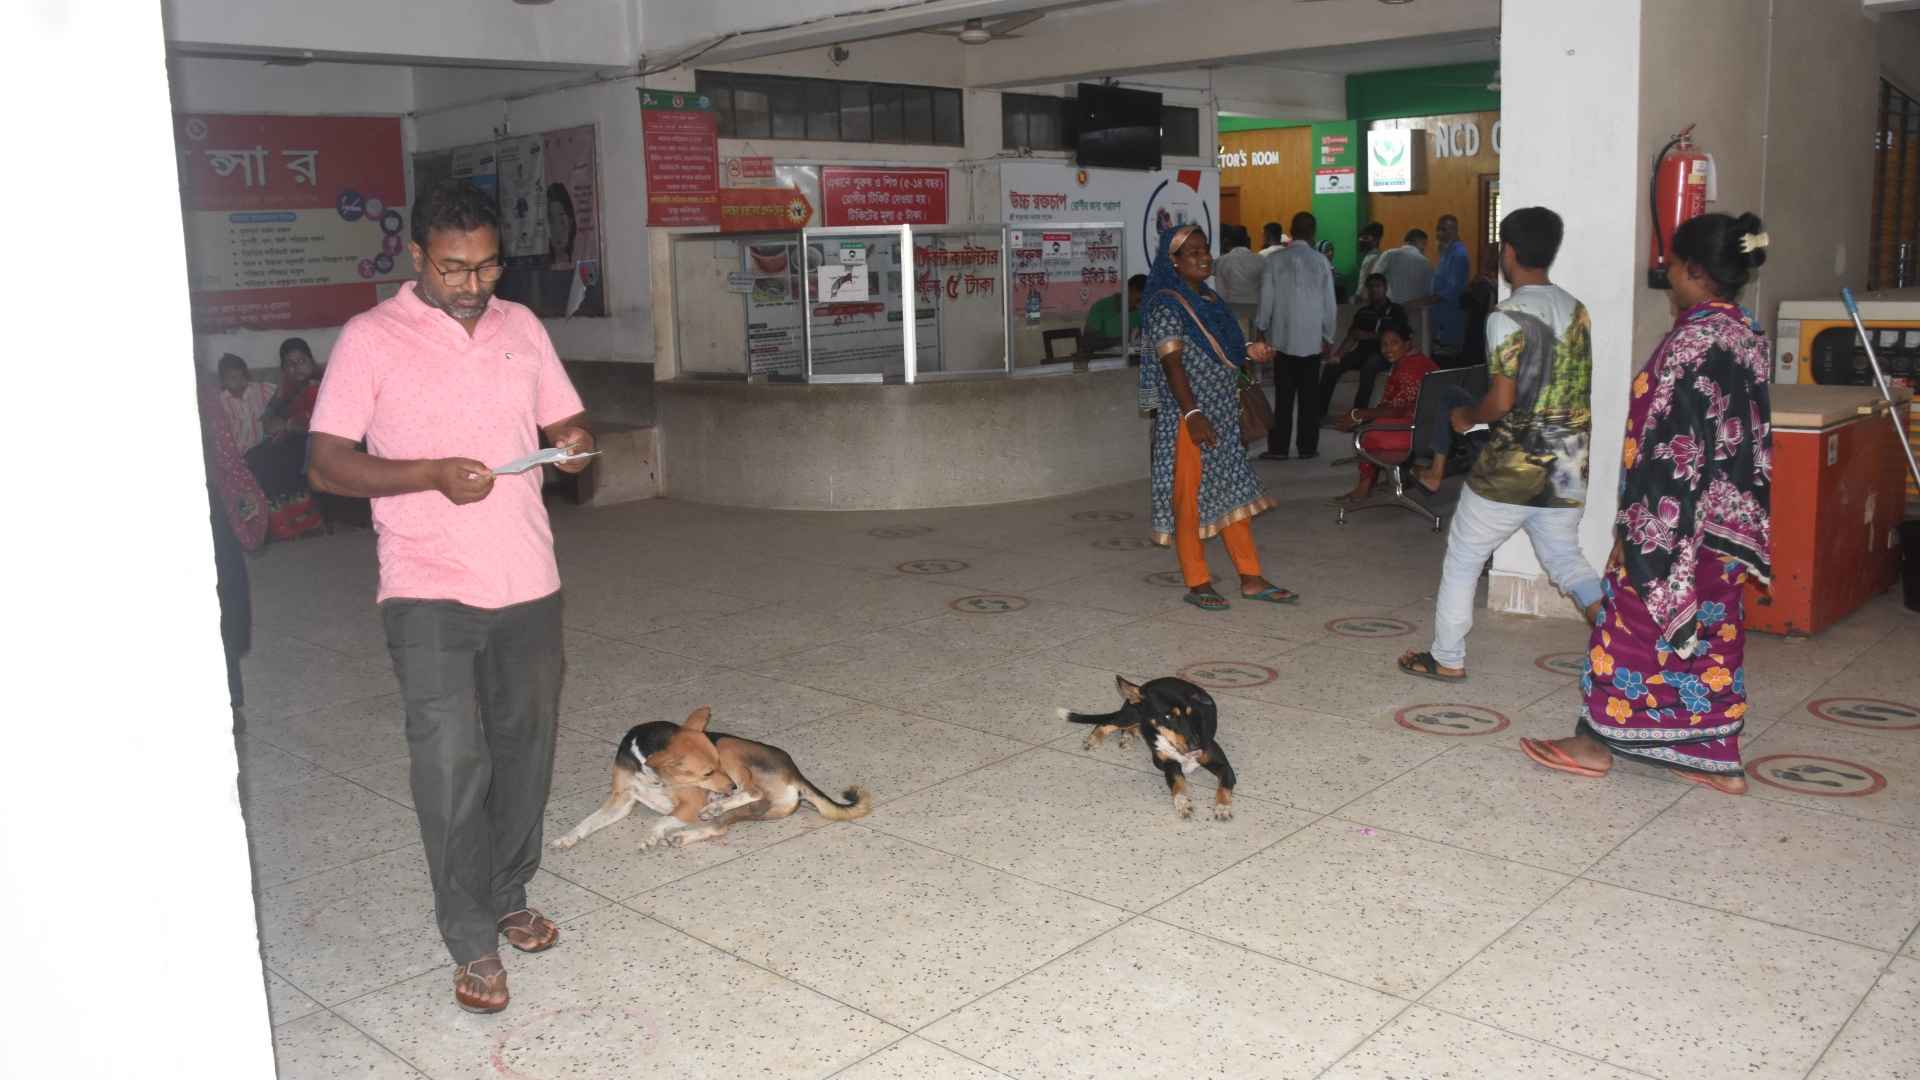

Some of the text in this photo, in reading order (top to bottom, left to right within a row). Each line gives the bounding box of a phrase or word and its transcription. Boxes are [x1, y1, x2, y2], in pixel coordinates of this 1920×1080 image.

[1435, 123, 1480, 159] NCD
[1217, 150, 1280, 168] TOR'S ROOM
[1032, 192, 1067, 211] রক্তচাপ
[963, 269, 995, 296] টাকা
